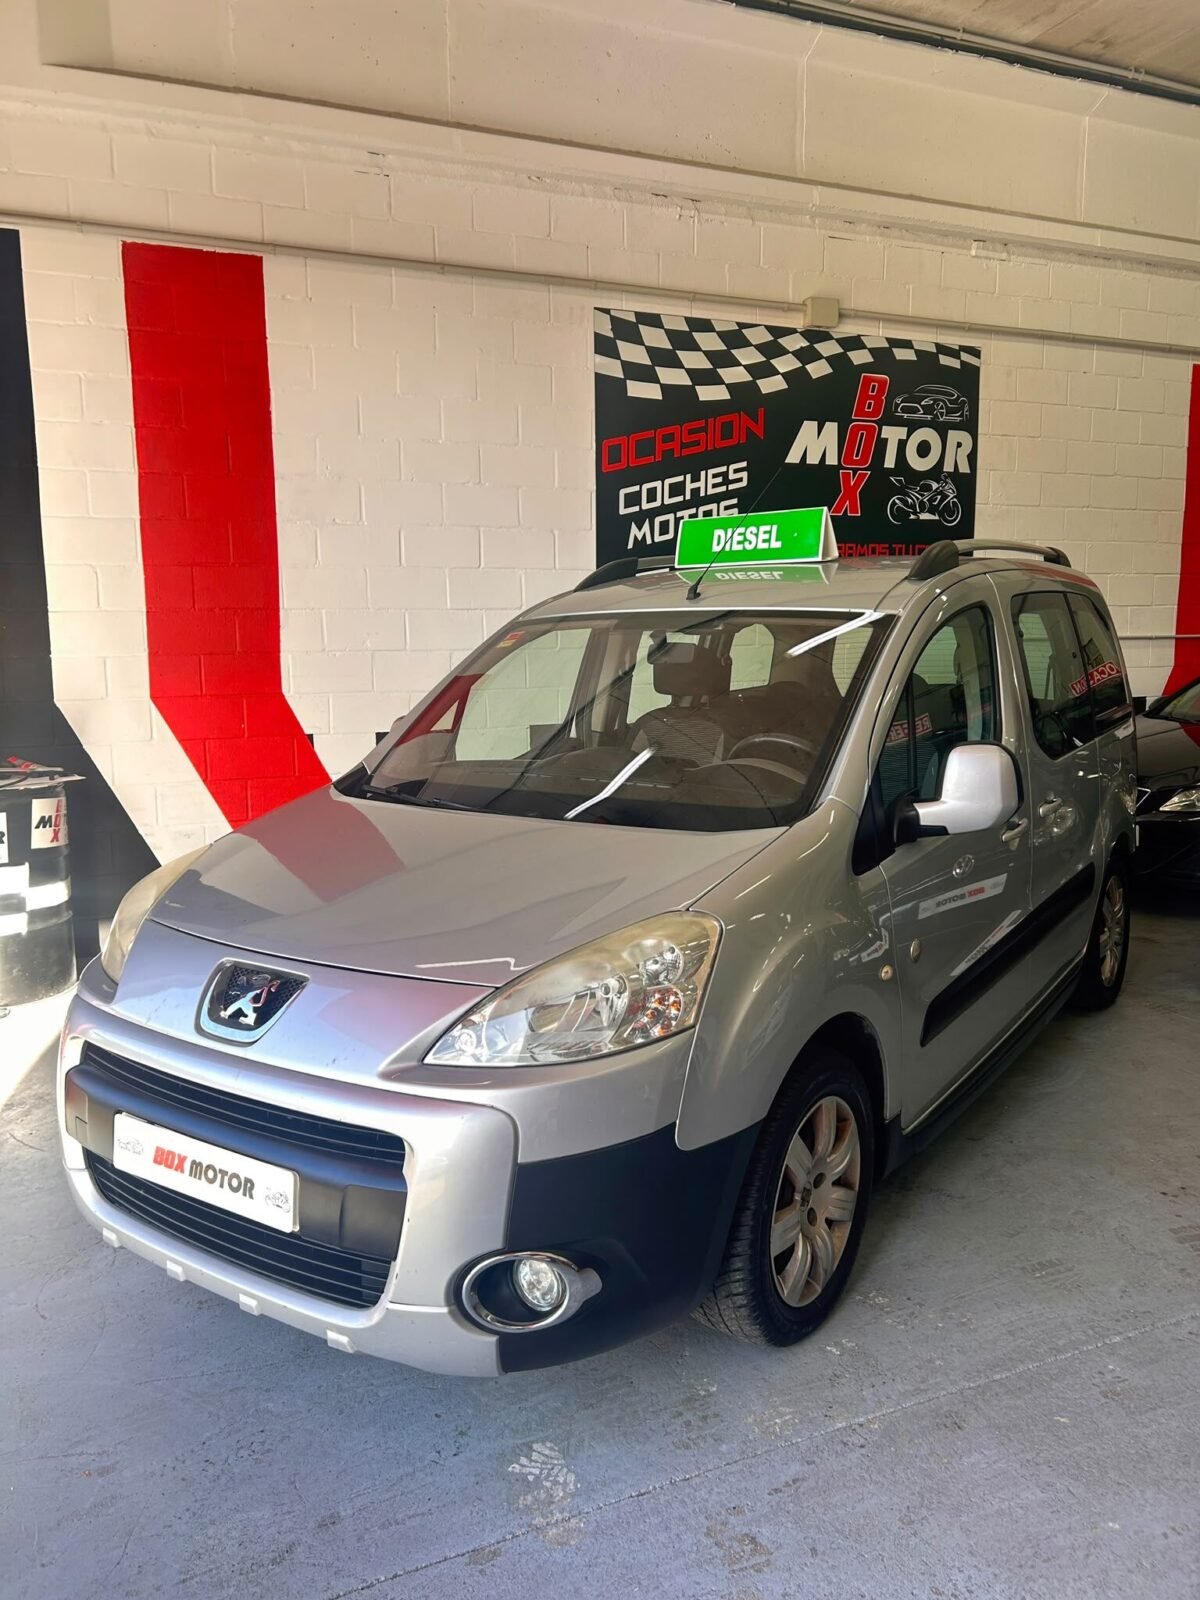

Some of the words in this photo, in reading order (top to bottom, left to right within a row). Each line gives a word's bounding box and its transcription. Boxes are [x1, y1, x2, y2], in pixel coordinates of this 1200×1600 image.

[602, 408, 765, 473] OCASION
[785, 420, 973, 474] MOTOR
[830, 373, 889, 516] BOX
[618, 460, 748, 516] COCHES
[712, 525, 782, 552] DIESEL
[153, 1146, 188, 1174] BOX
[188, 1158, 255, 1200] MOTOR
